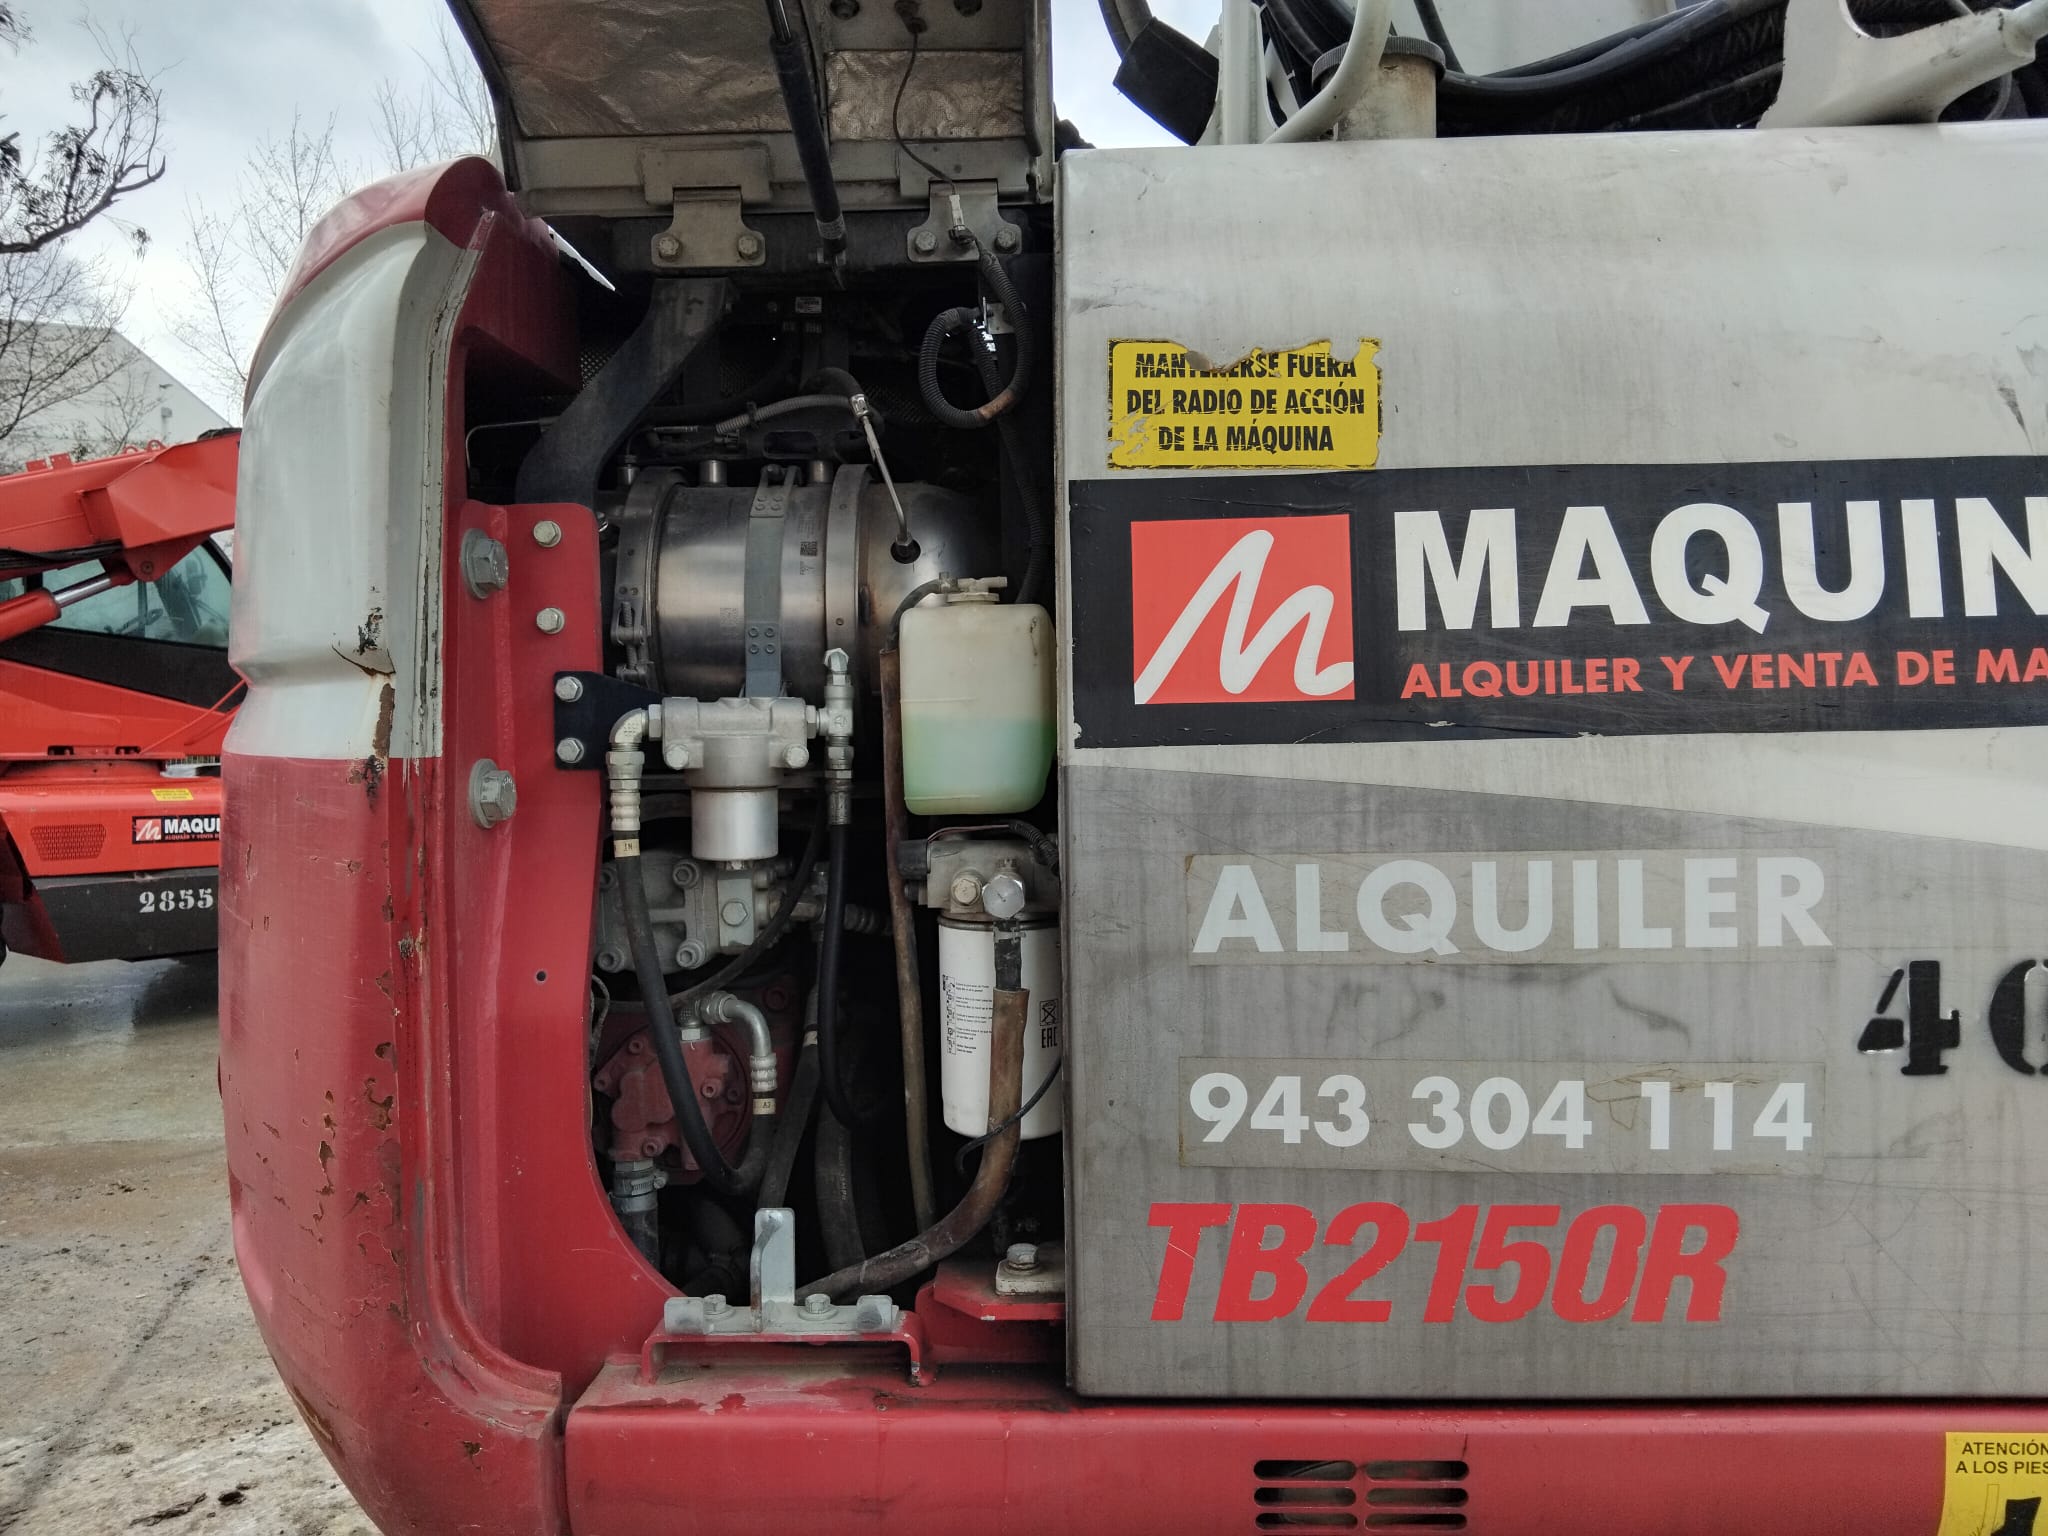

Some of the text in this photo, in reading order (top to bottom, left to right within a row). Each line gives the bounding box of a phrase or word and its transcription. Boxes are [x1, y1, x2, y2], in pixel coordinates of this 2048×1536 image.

[1287, 353, 1357, 378] FUERA
[1127, 381, 1365, 415] DEL RADIO DE ACCIÓN
[1158, 418, 1334, 454] DE LA MÁQUINA
[1394, 496, 2048, 634] MAQUIN
[1401, 648, 2048, 699] ALQUILER Y VENTA DE MA
[139, 888, 214, 913] 2855
[1192, 856, 1833, 957] ALQUILER
[1190, 1073, 1812, 1151] 943 304 114
[1148, 1202, 1740, 1322] TB2150R
[1961, 1439, 2048, 1456] ATENCIÓN
[1955, 1460, 2048, 1475] A LOS PIES
